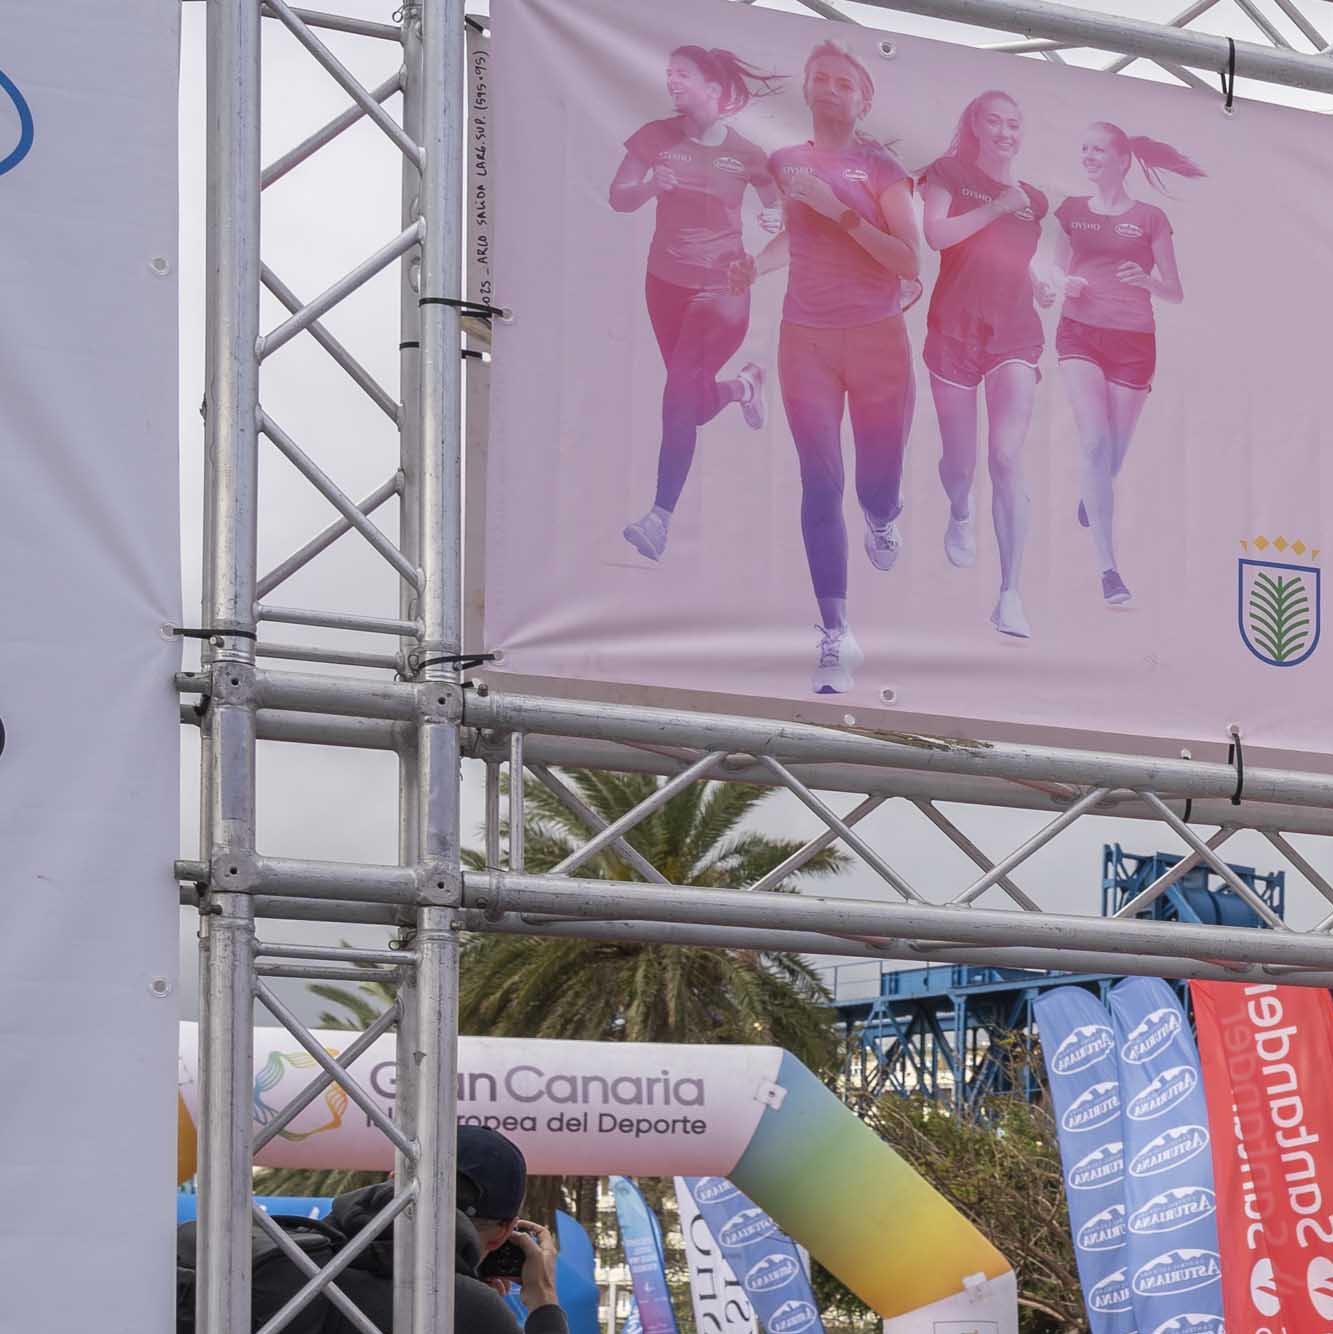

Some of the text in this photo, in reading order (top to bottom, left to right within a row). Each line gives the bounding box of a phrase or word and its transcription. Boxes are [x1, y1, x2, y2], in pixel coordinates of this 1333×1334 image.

[505, 1065, 704, 1106] Canaria
[547, 1112, 706, 1137] del Deporte
